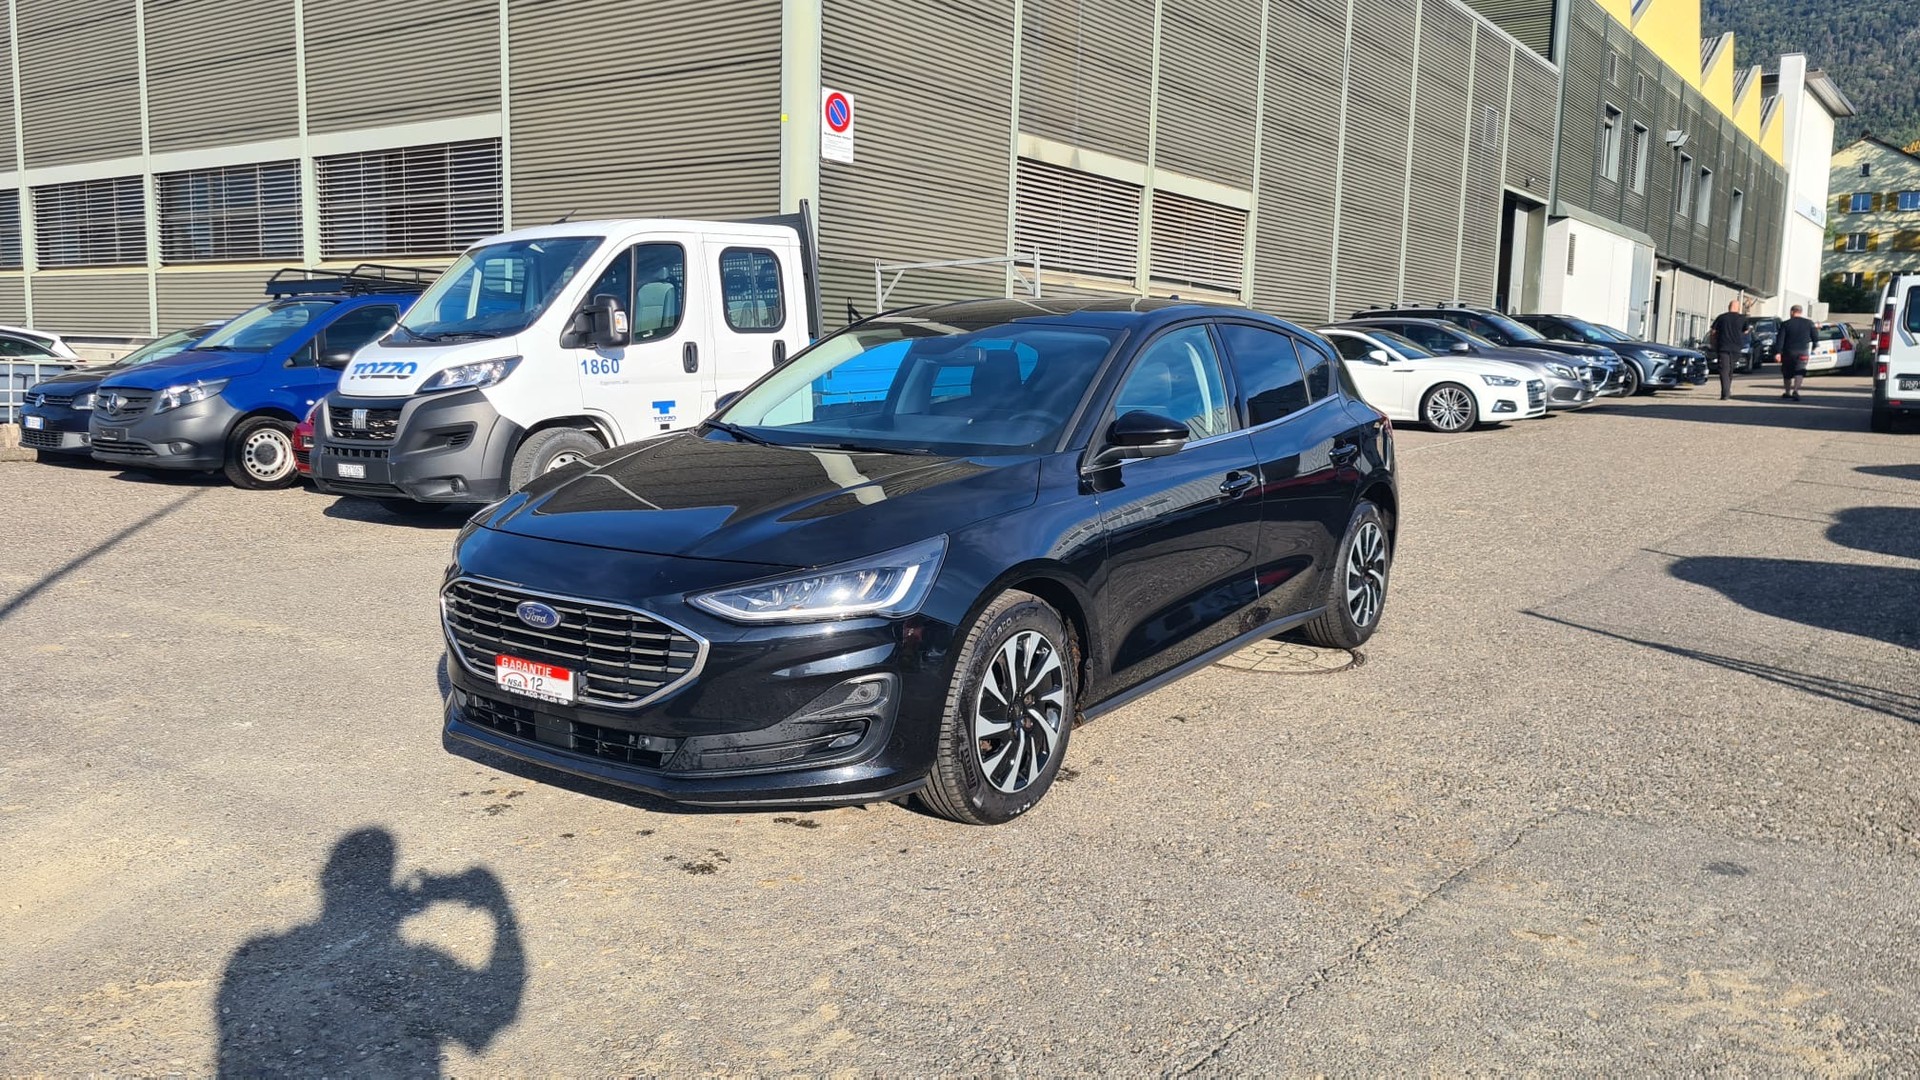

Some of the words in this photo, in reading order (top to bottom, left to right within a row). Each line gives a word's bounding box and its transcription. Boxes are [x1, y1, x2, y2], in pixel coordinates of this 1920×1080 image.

[350, 362, 418, 380] TOZZO
[581, 358, 620, 374] 1860
[524, 606, 548, 624] Ford
[502, 657, 552, 678] GARANTIE
[507, 678, 522, 688] NSA
[530, 676, 543, 692] 12
